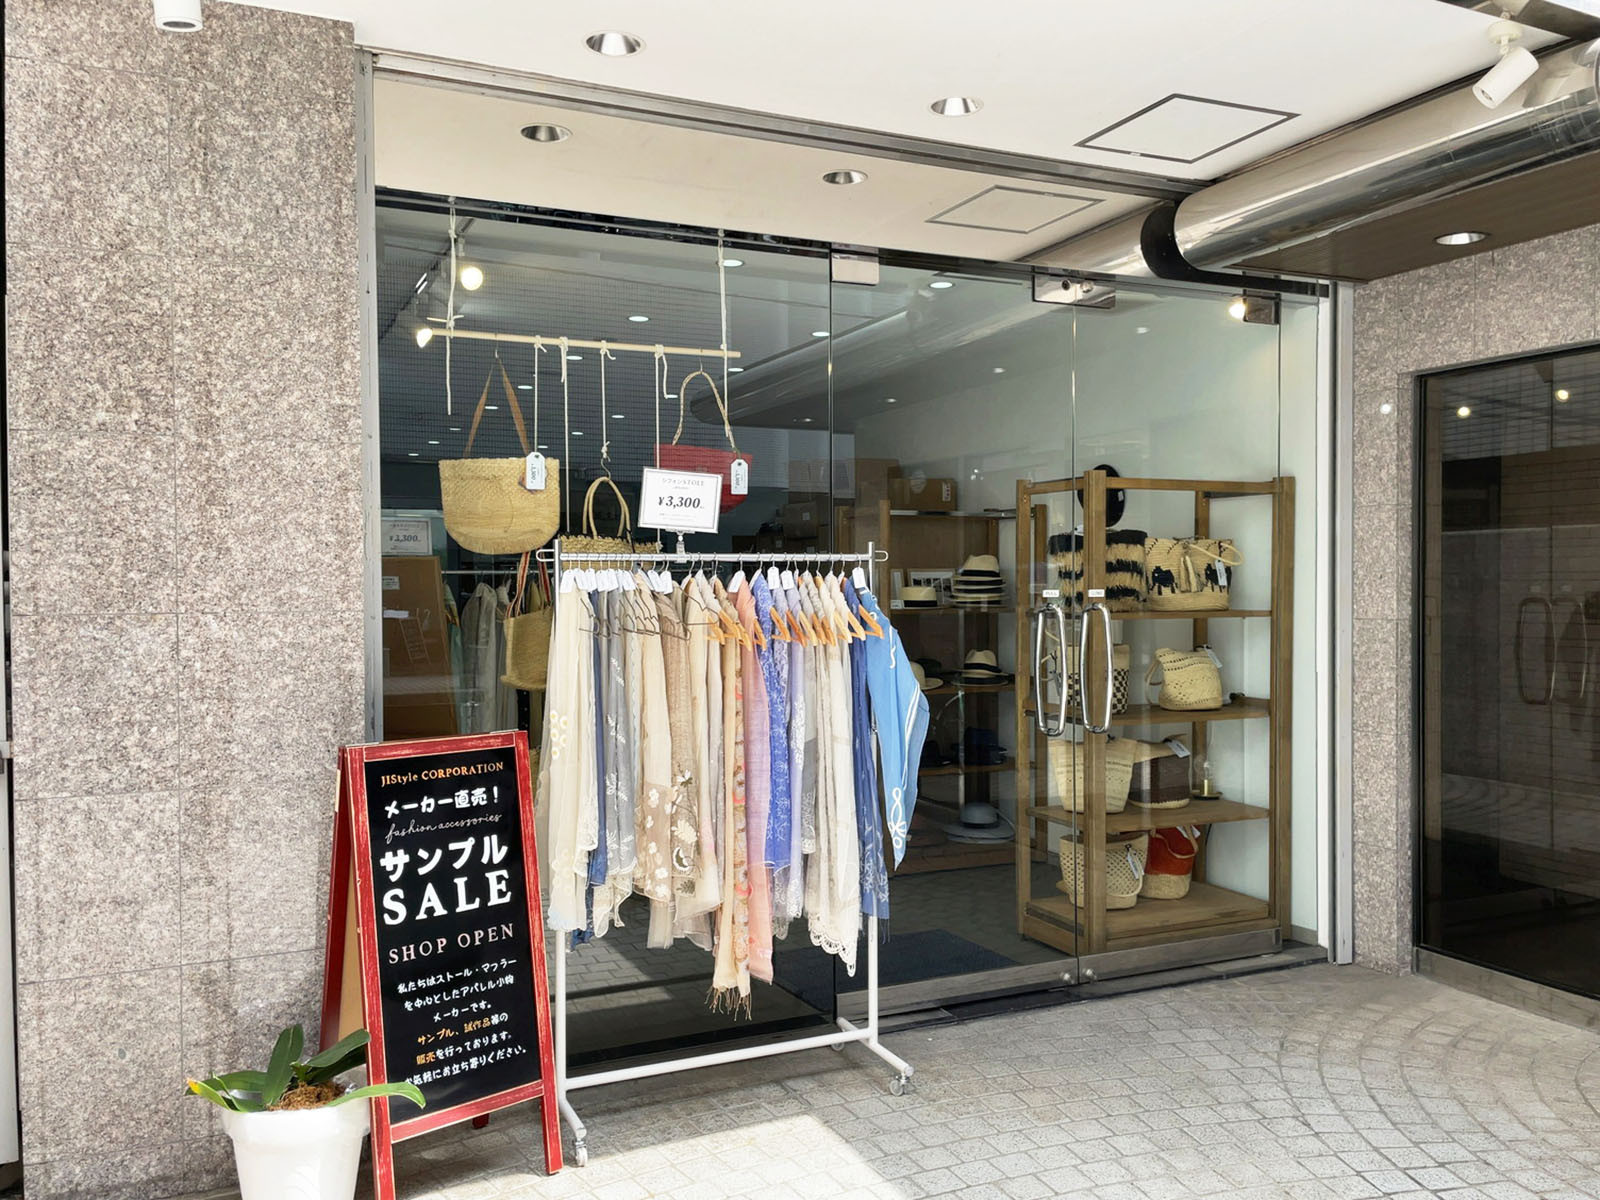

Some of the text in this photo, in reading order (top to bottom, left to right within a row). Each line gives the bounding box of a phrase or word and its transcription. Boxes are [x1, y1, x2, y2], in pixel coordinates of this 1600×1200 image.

[658, 495, 701, 509] ¥3,300
[381, 761, 504, 787] JIStyle CORPORATION
[385, 813, 502, 844] fashion accessories
[379, 834, 508, 883] サンプル
[382, 869, 512, 926] SALE
[388, 923, 514, 964] SHOP OPEN
[397, 958, 517, 994] 私たちはストール・マフラー
[404, 974, 514, 1012] を中心としたアパレル小物
[433, 1000, 492, 1023] メーカーです。
